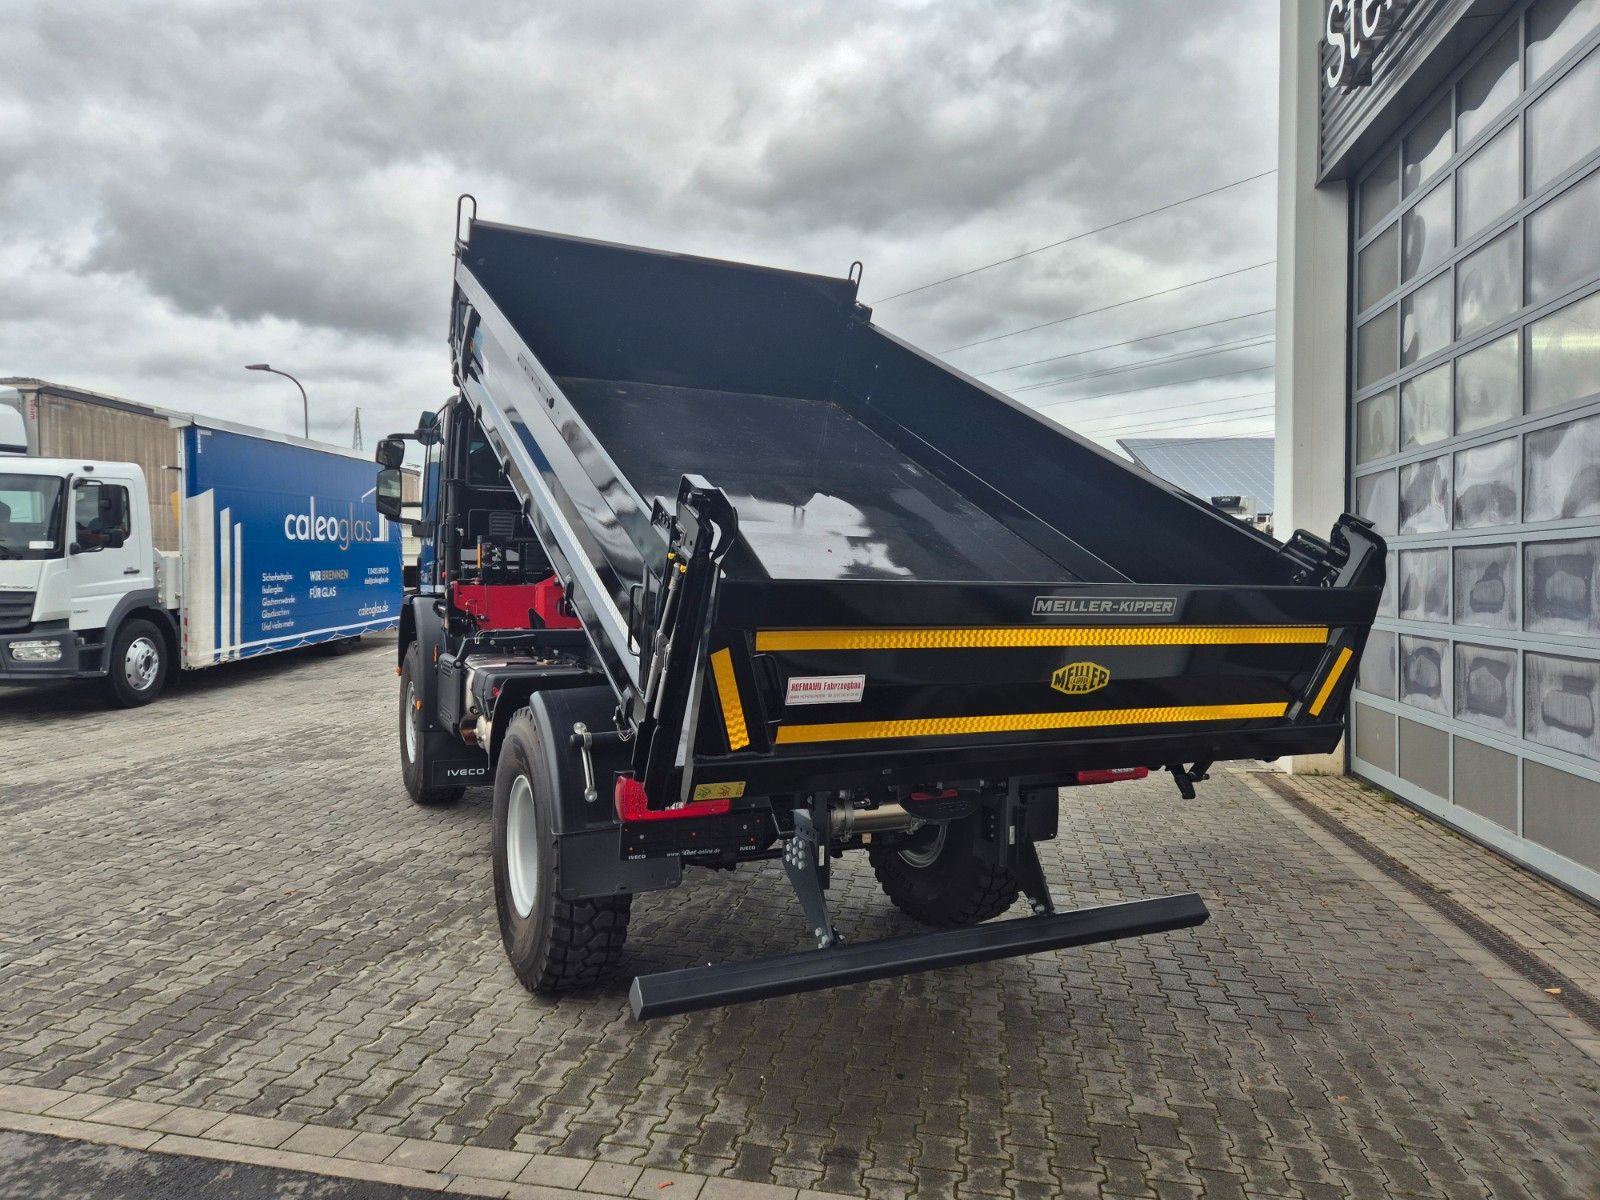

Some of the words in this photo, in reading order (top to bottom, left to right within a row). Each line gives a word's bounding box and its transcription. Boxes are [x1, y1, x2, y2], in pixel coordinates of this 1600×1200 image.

[1326, 0, 1393, 88] Ste
[284, 495, 372, 551] caleoglas
[309, 586, 321, 598] FÜR
[322, 587, 336, 597] GLAS
[358, 600, 389, 617] caleoglas.de
[1036, 599, 1174, 613] MEILLER-KIPPER
[1053, 664, 1107, 692] MEILLER
[790, 682, 822, 692] HOFMANN
[447, 768, 485, 777] IVECO
